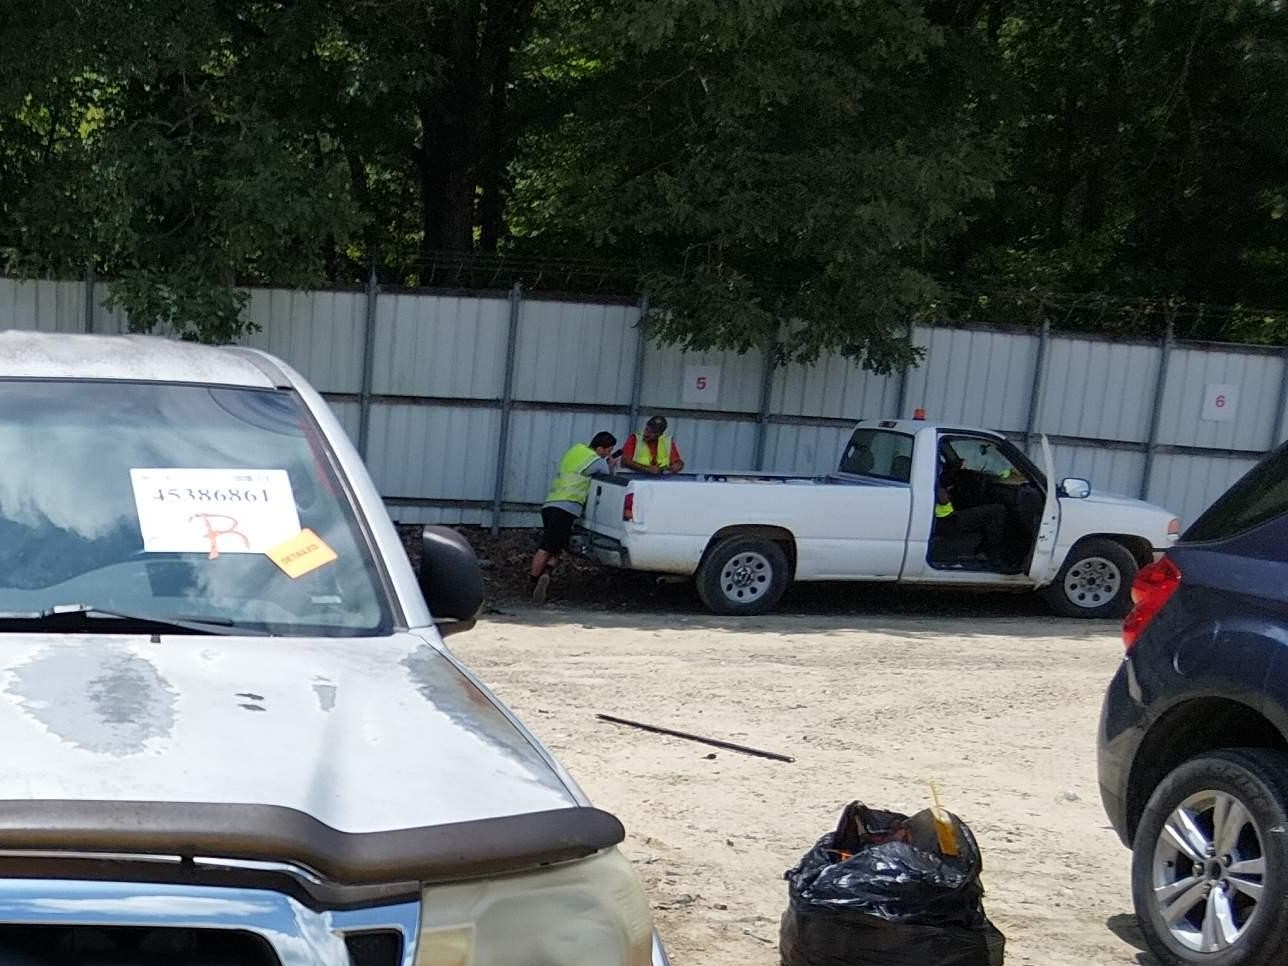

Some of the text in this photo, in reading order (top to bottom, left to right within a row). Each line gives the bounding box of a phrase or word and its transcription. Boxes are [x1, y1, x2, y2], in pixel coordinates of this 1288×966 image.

[696, 376, 707, 390] 5
[1215, 394, 1225, 408] 6
[152, 487, 270, 503] 45386861
